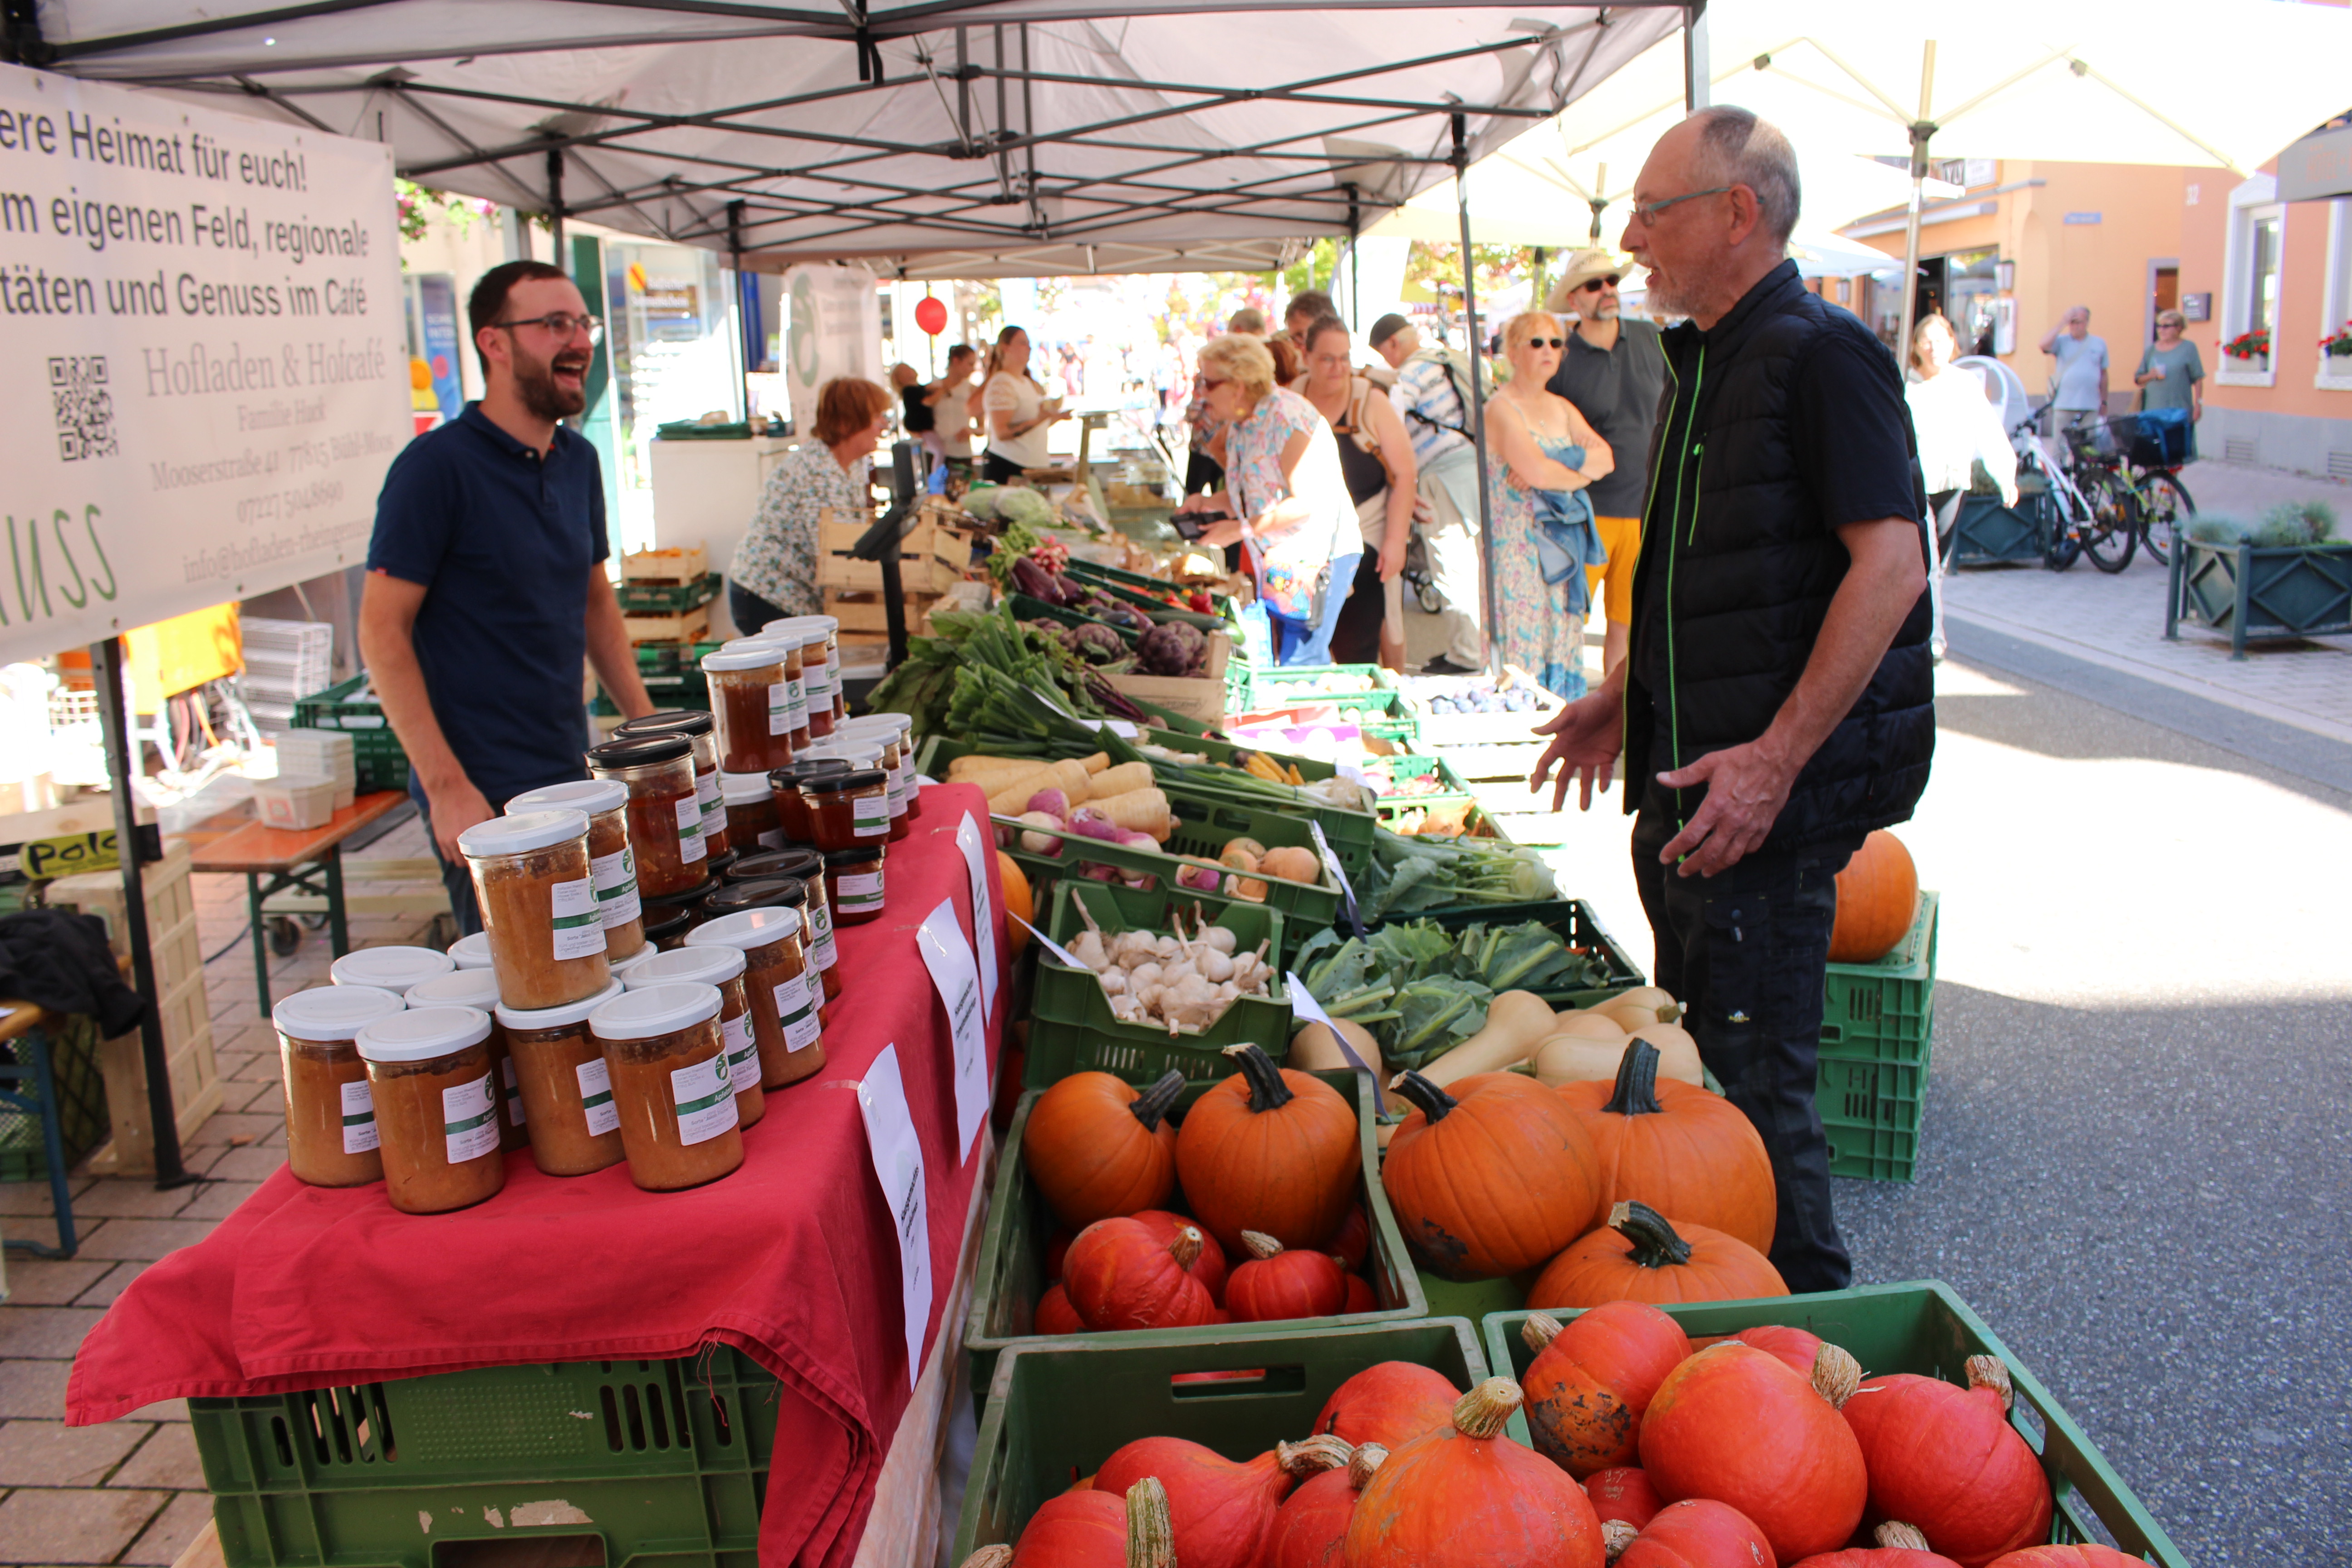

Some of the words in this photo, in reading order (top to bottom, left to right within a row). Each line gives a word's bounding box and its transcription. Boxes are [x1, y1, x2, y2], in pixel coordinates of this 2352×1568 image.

[66, 110, 185, 174] Heimat
[191, 133, 229, 181] für
[239, 149, 308, 192] euch!
[52, 186, 183, 251] eigenen
[191, 204, 259, 259] Feld,
[265, 215, 369, 264] regionale
[106, 269, 167, 314] und
[177, 273, 281, 316] Genuss
[285, 275, 318, 316] im
[325, 278, 368, 315] Café
[141, 341, 276, 397] Hofladen
[281, 343, 301, 387] &
[306, 337, 386, 386] Hofcafé
